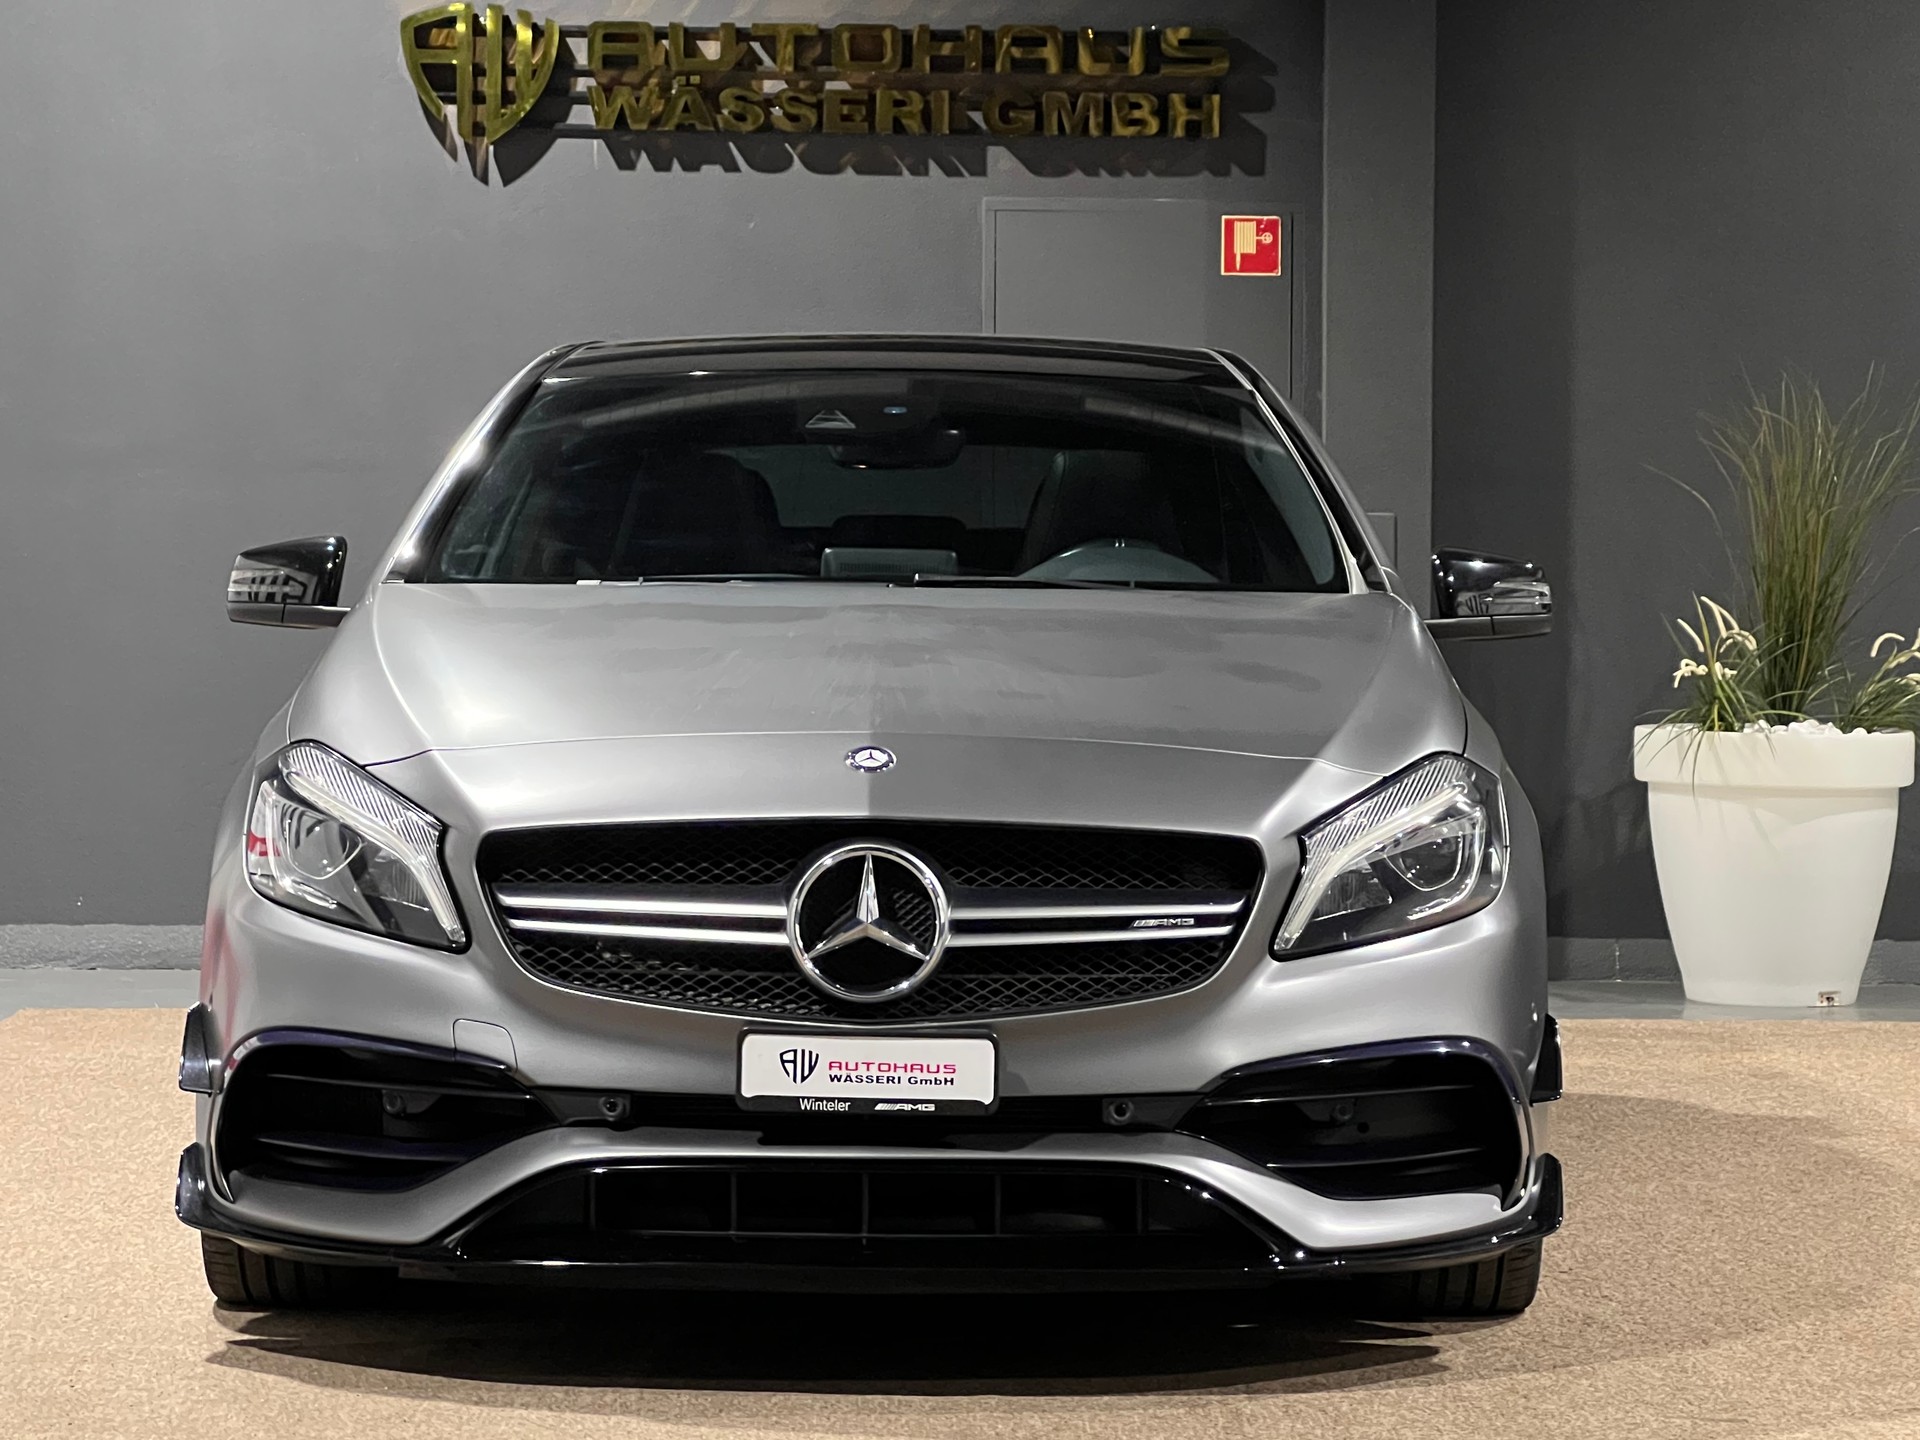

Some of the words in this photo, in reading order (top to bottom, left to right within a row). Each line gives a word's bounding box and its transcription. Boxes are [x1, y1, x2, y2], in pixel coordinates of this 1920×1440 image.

[587, 20, 1231, 77] AUTOHAUS
[586, 75, 950, 136] WÄSSERI
[982, 91, 1221, 139] GMBH
[828, 1061, 957, 1074] AUTOHAUS
[828, 1073, 901, 1085] WÄSSERI
[907, 1076, 955, 1086] GmbH
[799, 1098, 851, 1112] Winteler
[893, 1103, 936, 1112] AMG
